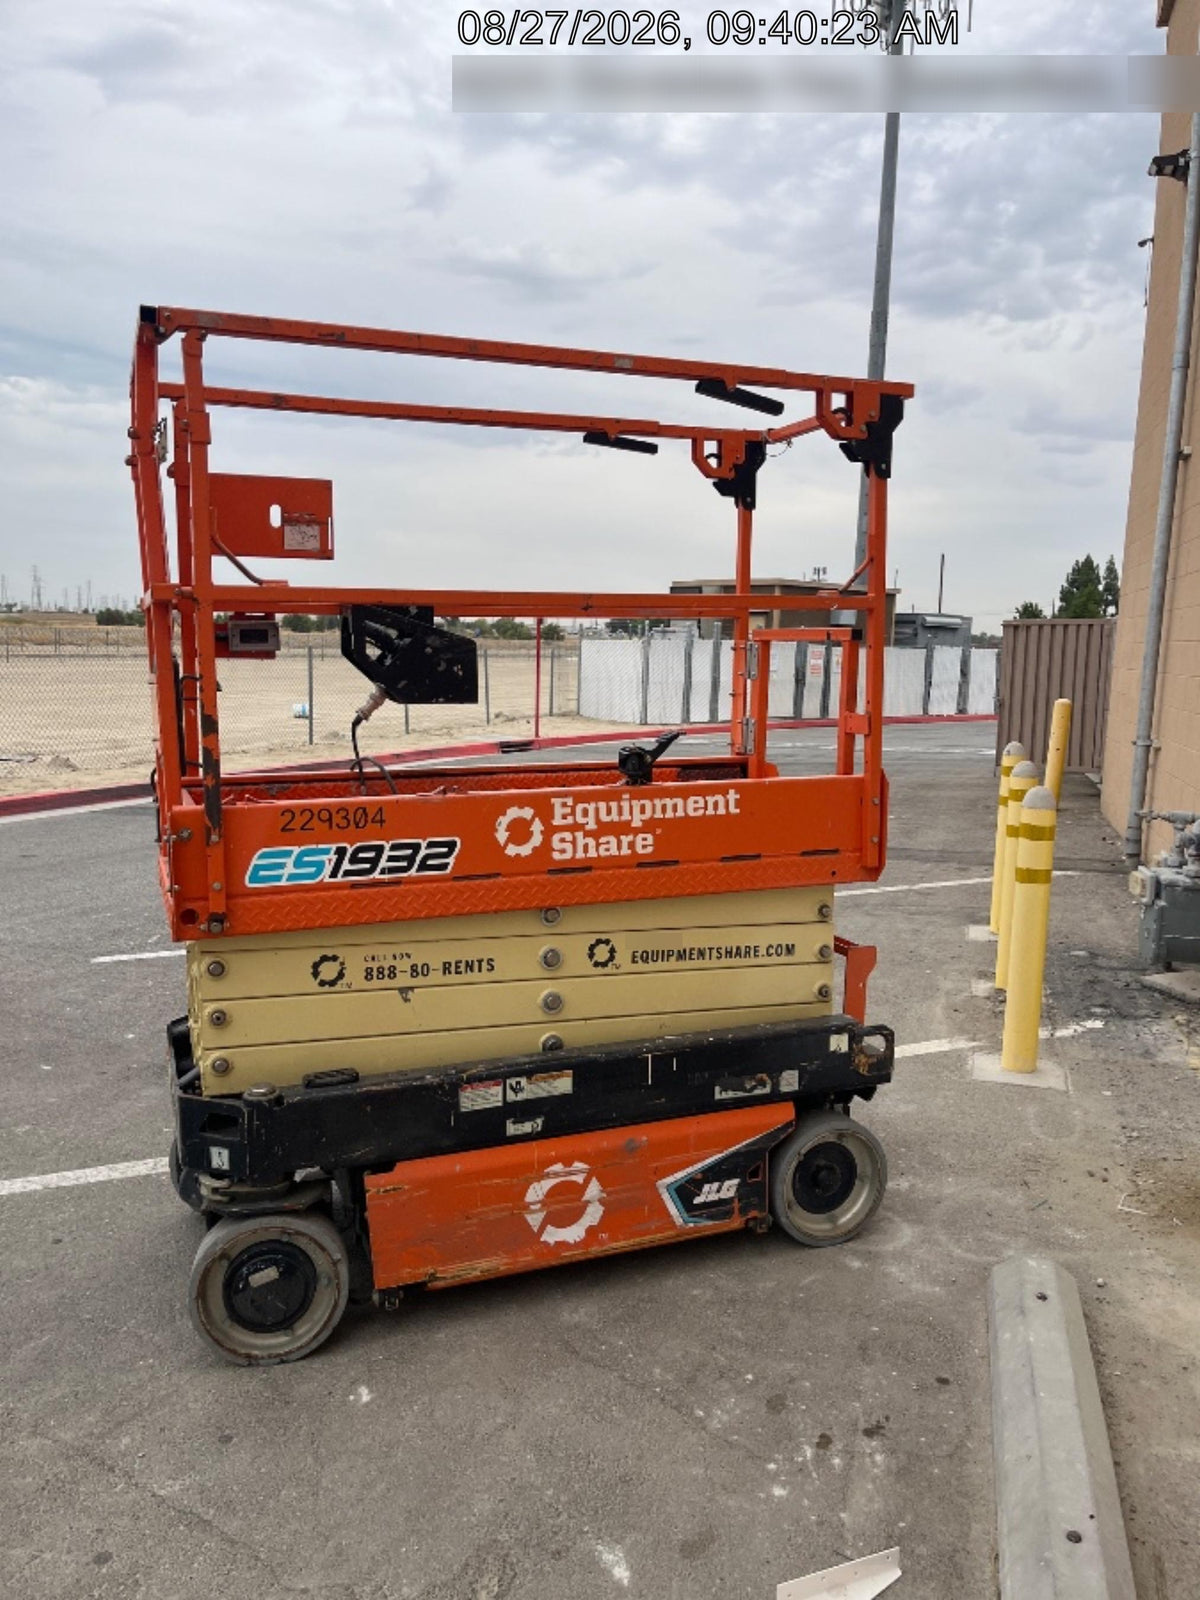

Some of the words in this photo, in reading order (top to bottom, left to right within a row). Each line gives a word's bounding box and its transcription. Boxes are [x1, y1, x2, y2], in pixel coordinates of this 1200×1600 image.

[280, 807, 386, 833] 229304
[551, 789, 741, 830] Equipment
[551, 830, 654, 861] Share
[245, 837, 460, 887] ES1932
[630, 943, 796, 965] EQUIPMENTSHARE.COM
[363, 957, 496, 982] 888-80-RENTS
